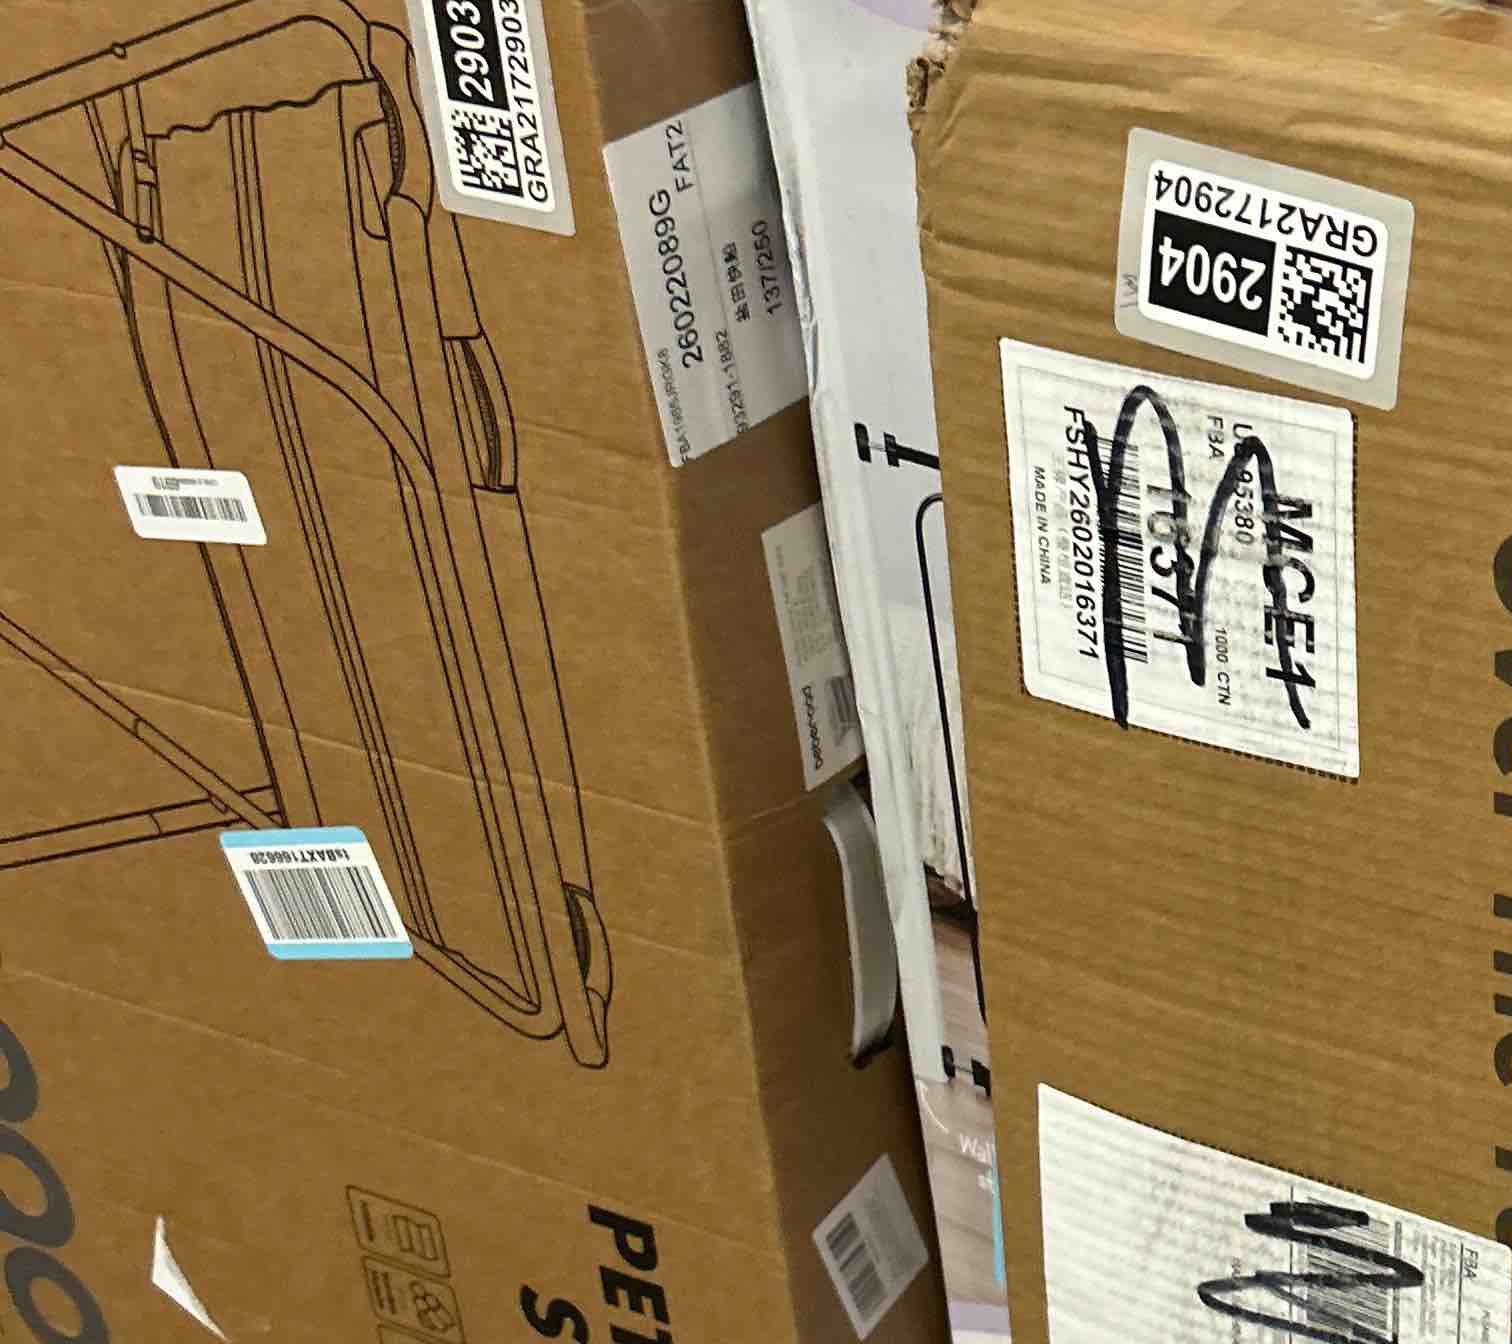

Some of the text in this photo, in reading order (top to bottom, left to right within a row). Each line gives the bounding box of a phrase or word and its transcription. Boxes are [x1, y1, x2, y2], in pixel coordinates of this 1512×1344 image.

[446, 0, 494, 104] 2903
[662, 119, 696, 193] FAT2
[1154, 169, 1379, 257] GRA2172904
[648, 188, 704, 370] 26022089G
[752, 219, 782, 316] 137/250
[1158, 235, 1268, 311] 2904
[1034, 464, 1052, 585] MADE IN CHINA
[1062, 403, 1101, 661] FSHY2602016371
[1214, 625, 1229, 665] 1000
[1216, 668, 1231, 707] CTN
